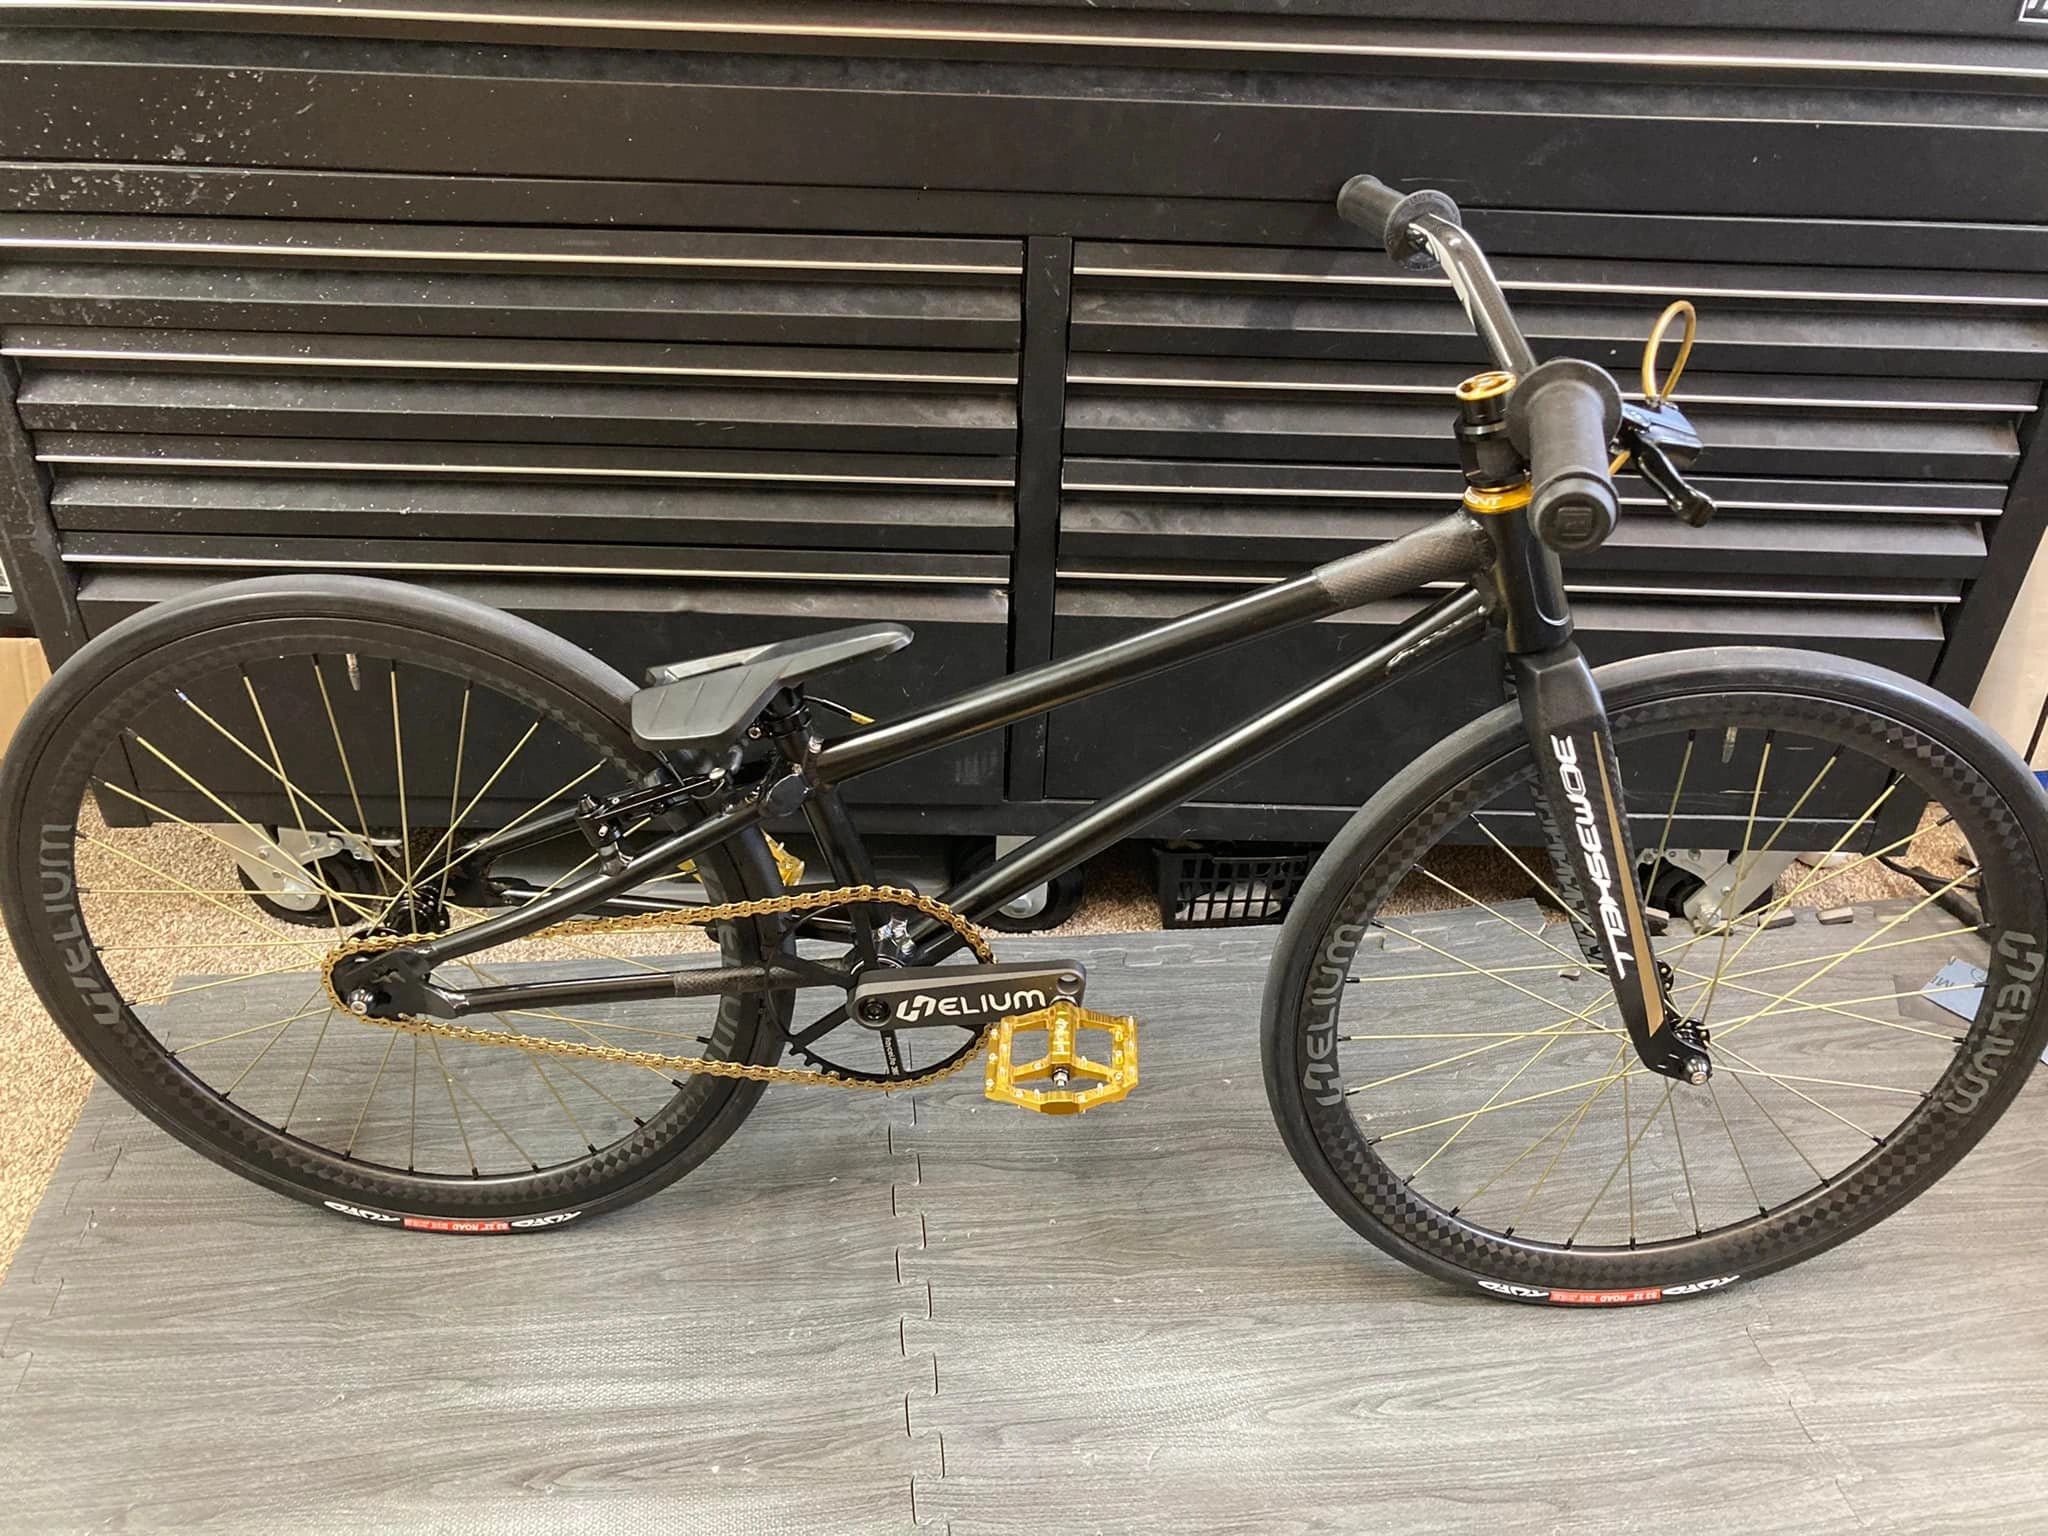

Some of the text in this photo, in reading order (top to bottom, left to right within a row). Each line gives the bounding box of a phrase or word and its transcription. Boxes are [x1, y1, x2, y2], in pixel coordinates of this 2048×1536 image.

[40, 824, 121, 1025] HELIUM
[895, 989, 1046, 1022] HELIUM
[1303, 923, 1365, 1107] HELIUM
[1944, 930, 2045, 1115] HELIUM
[323, 1200, 401, 1222] TUFO
[511, 1210, 583, 1228] TUFO
[1477, 1280, 1549, 1298] TUFO
[1662, 1274, 1740, 1296] TUFO
